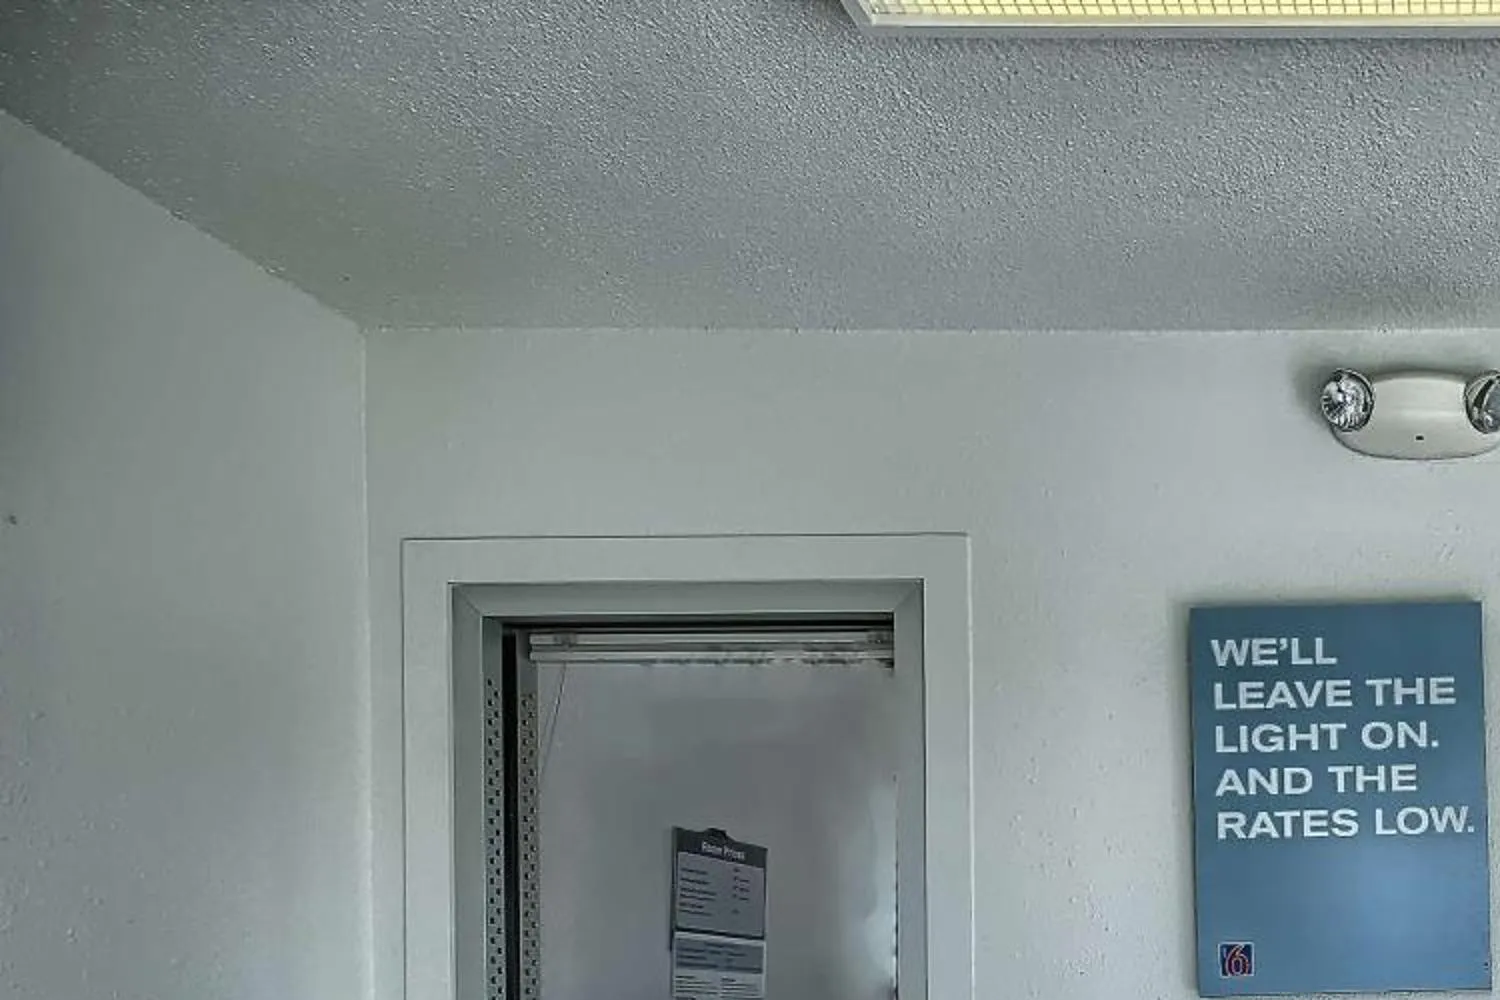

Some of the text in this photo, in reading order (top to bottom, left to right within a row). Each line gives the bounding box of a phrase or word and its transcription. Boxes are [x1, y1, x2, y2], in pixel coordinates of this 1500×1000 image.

[1211, 637, 1338, 667] WE'LL
[1213, 676, 1457, 710] LEAVE THE
[1215, 720, 1440, 753] LIGHT ON.
[1215, 763, 1418, 797] AND THE
[1217, 805, 1475, 840] RATES LOW.
